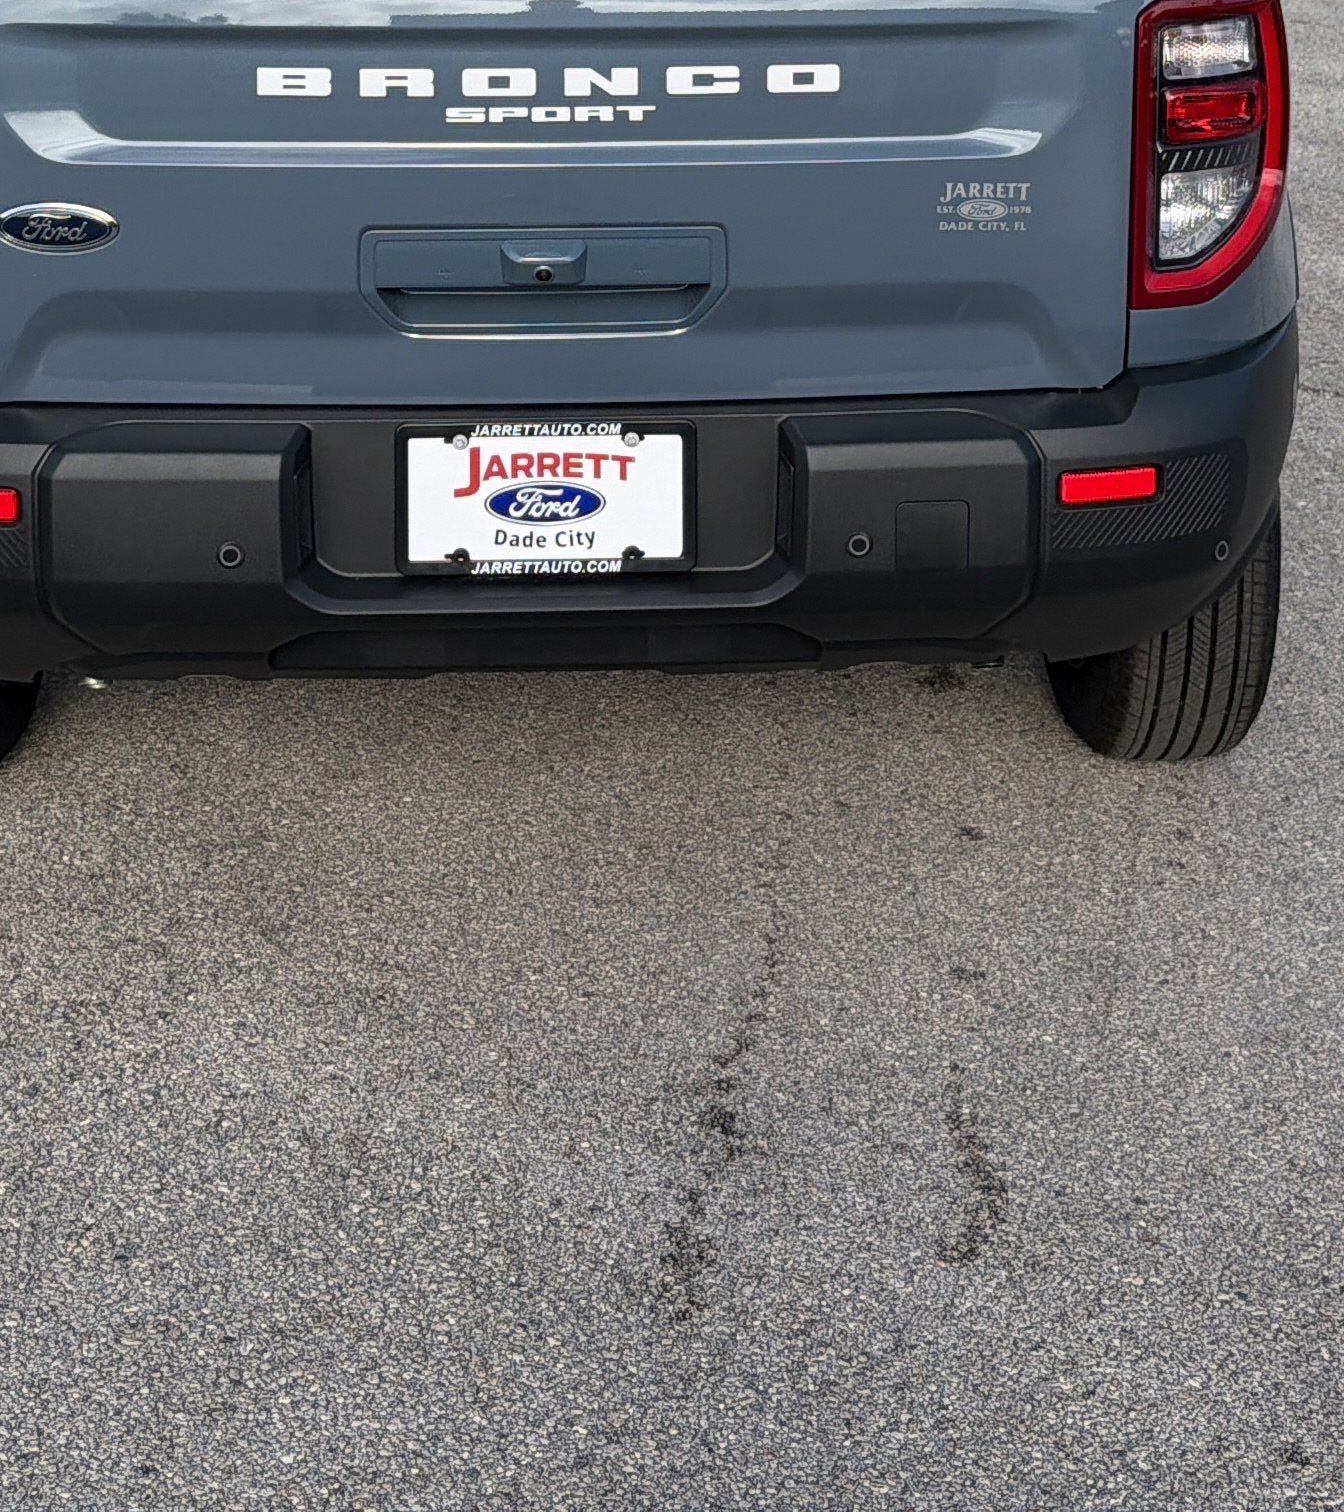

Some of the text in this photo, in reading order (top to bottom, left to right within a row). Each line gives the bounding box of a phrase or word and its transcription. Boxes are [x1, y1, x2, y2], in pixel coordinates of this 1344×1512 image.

[256, 64, 841, 98] BRONCO
[445, 105, 656, 123] SPORT
[940, 182, 1031, 203] JARRETT
[936, 206, 956, 214] EST.
[968, 203, 998, 216] Ford
[21, 213, 88, 241] Ford
[939, 221, 1027, 232] DADE CITY, FL
[470, 423, 622, 437] JARRETTAUTO.COM
[453, 446, 636, 498] JARRETT
[508, 488, 581, 518] Ford
[494, 529, 596, 549] Dade City
[470, 560, 622, 575] JARRETTAUTO.COM
